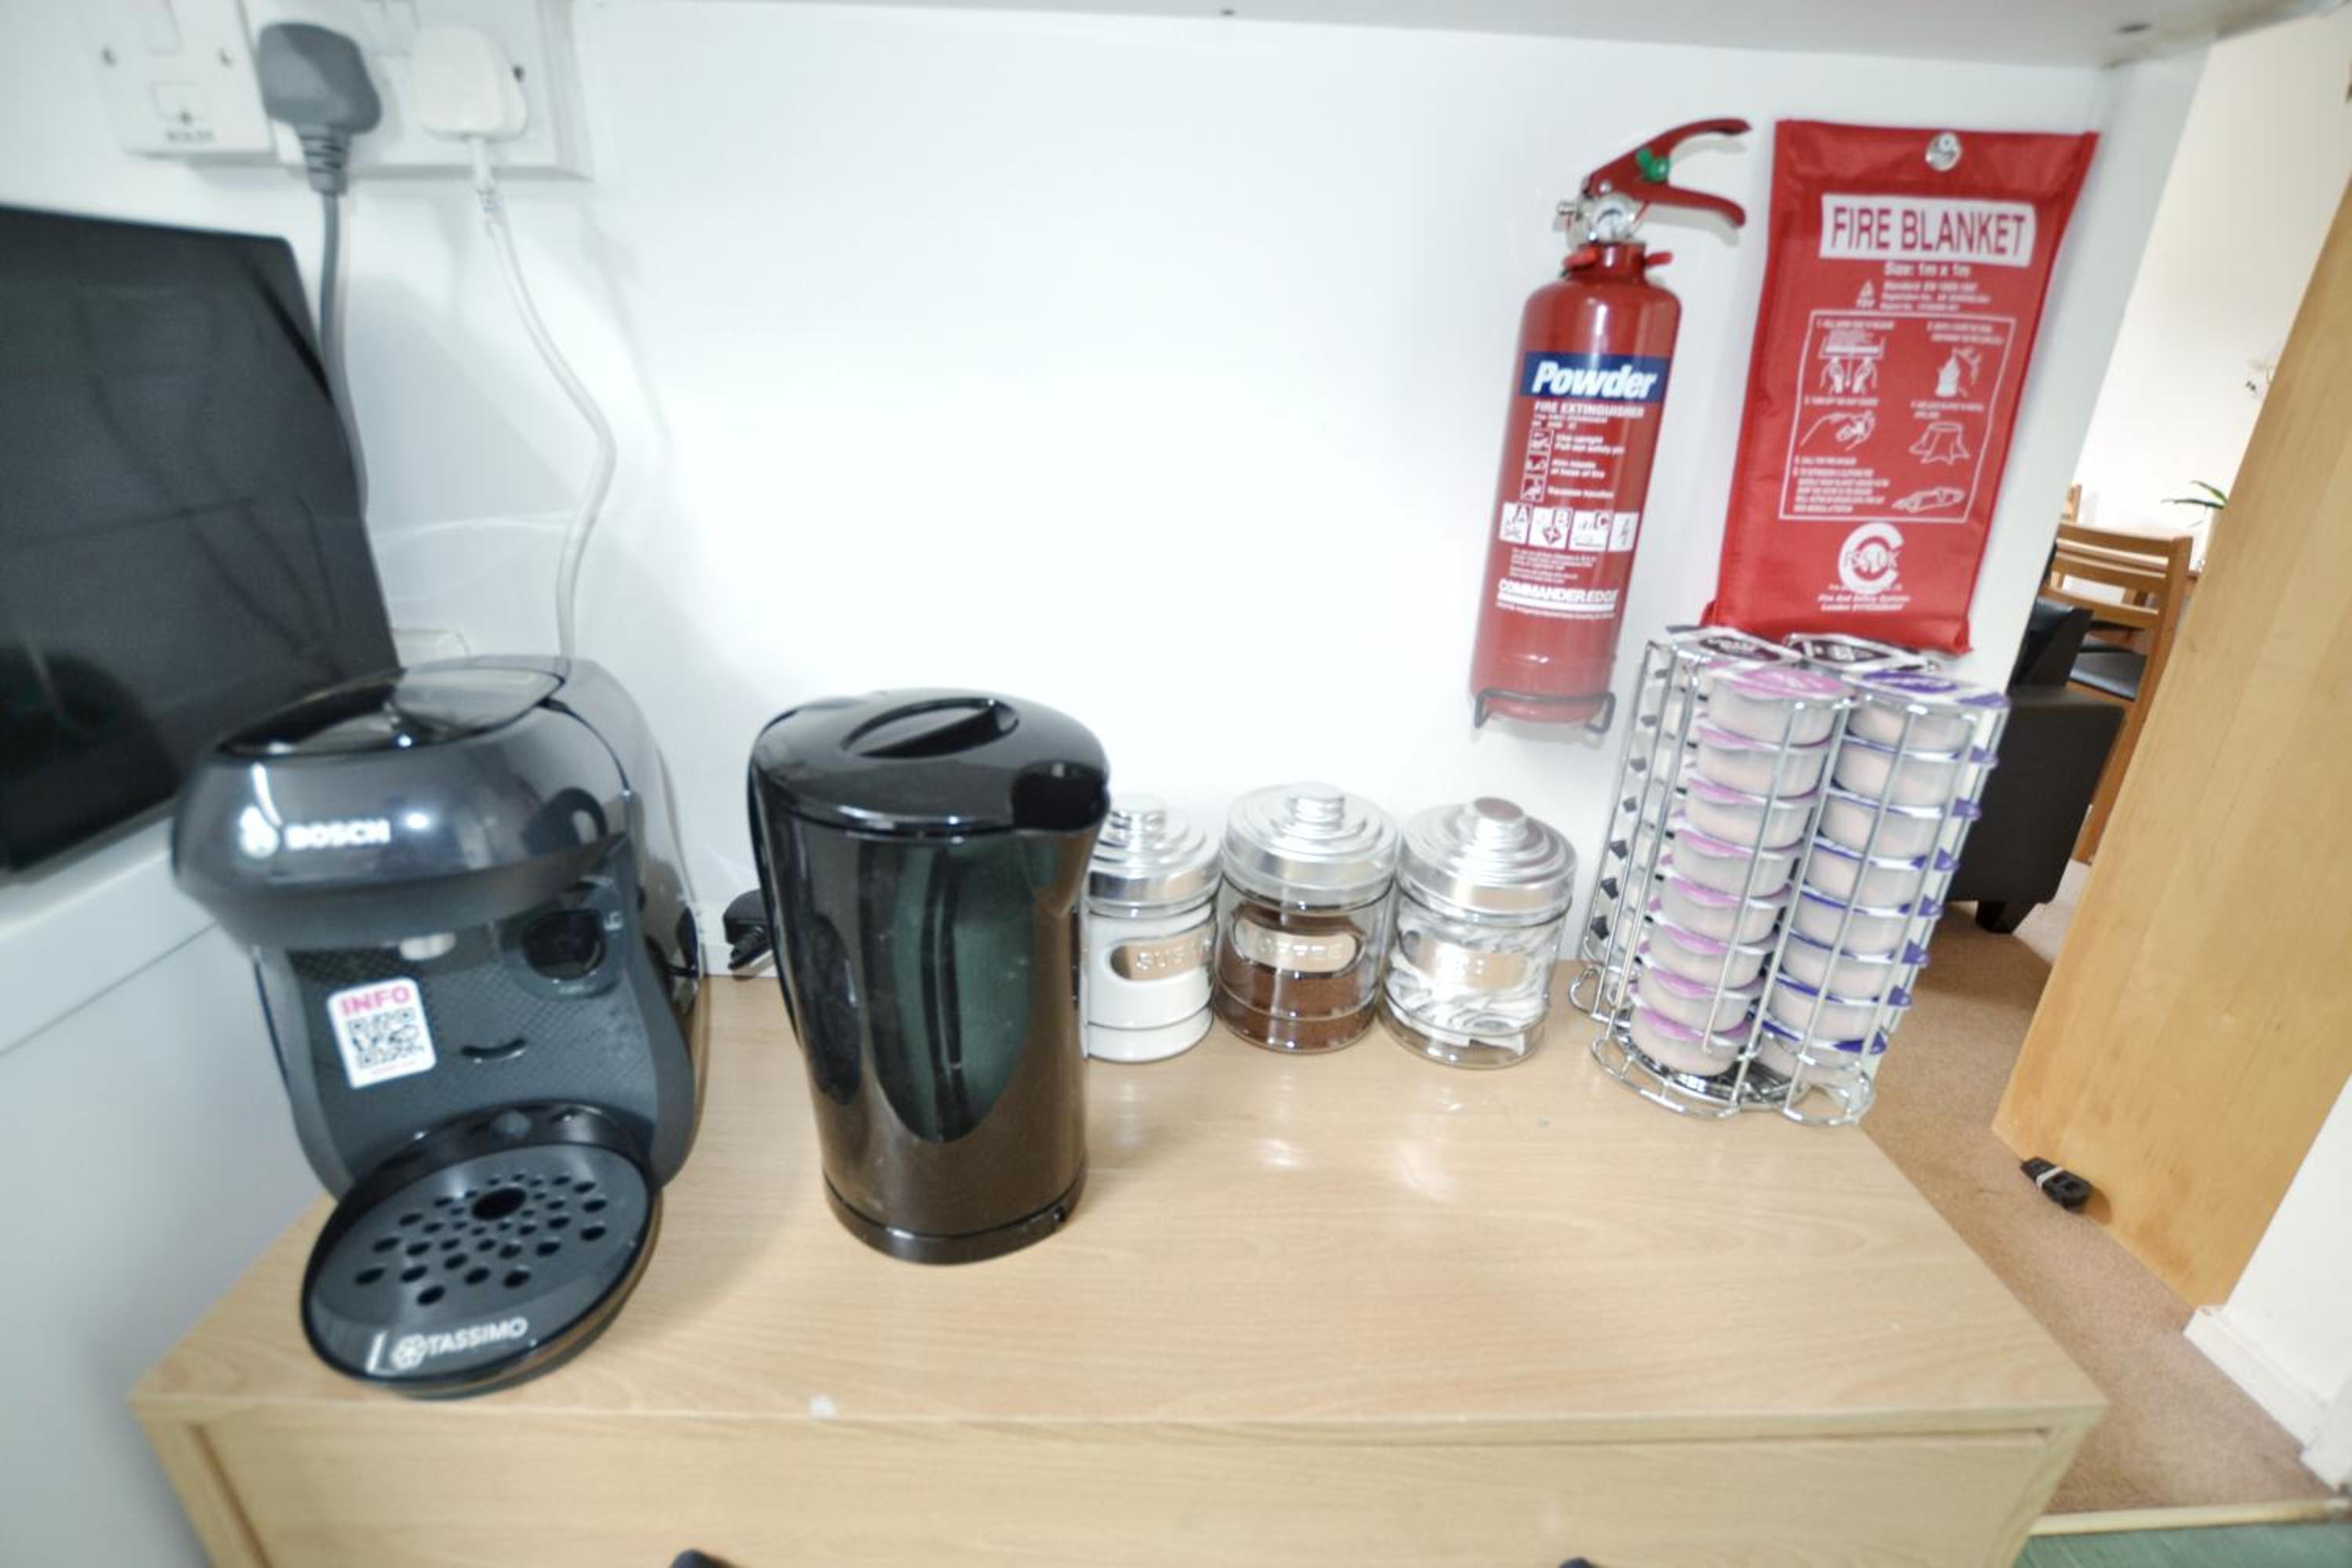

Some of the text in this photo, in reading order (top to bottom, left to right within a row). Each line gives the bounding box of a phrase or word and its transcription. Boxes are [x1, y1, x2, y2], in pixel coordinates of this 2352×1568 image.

[1831, 206, 2026, 256] FIRE BLANKET
[1531, 361, 1659, 399] Powder
[1534, 400, 1645, 418] FIRE EXTINGUISHER
[285, 818, 391, 851] BOSCH
[339, 984, 412, 1017] INFO
[426, 1317, 528, 1356] TASSIMO
